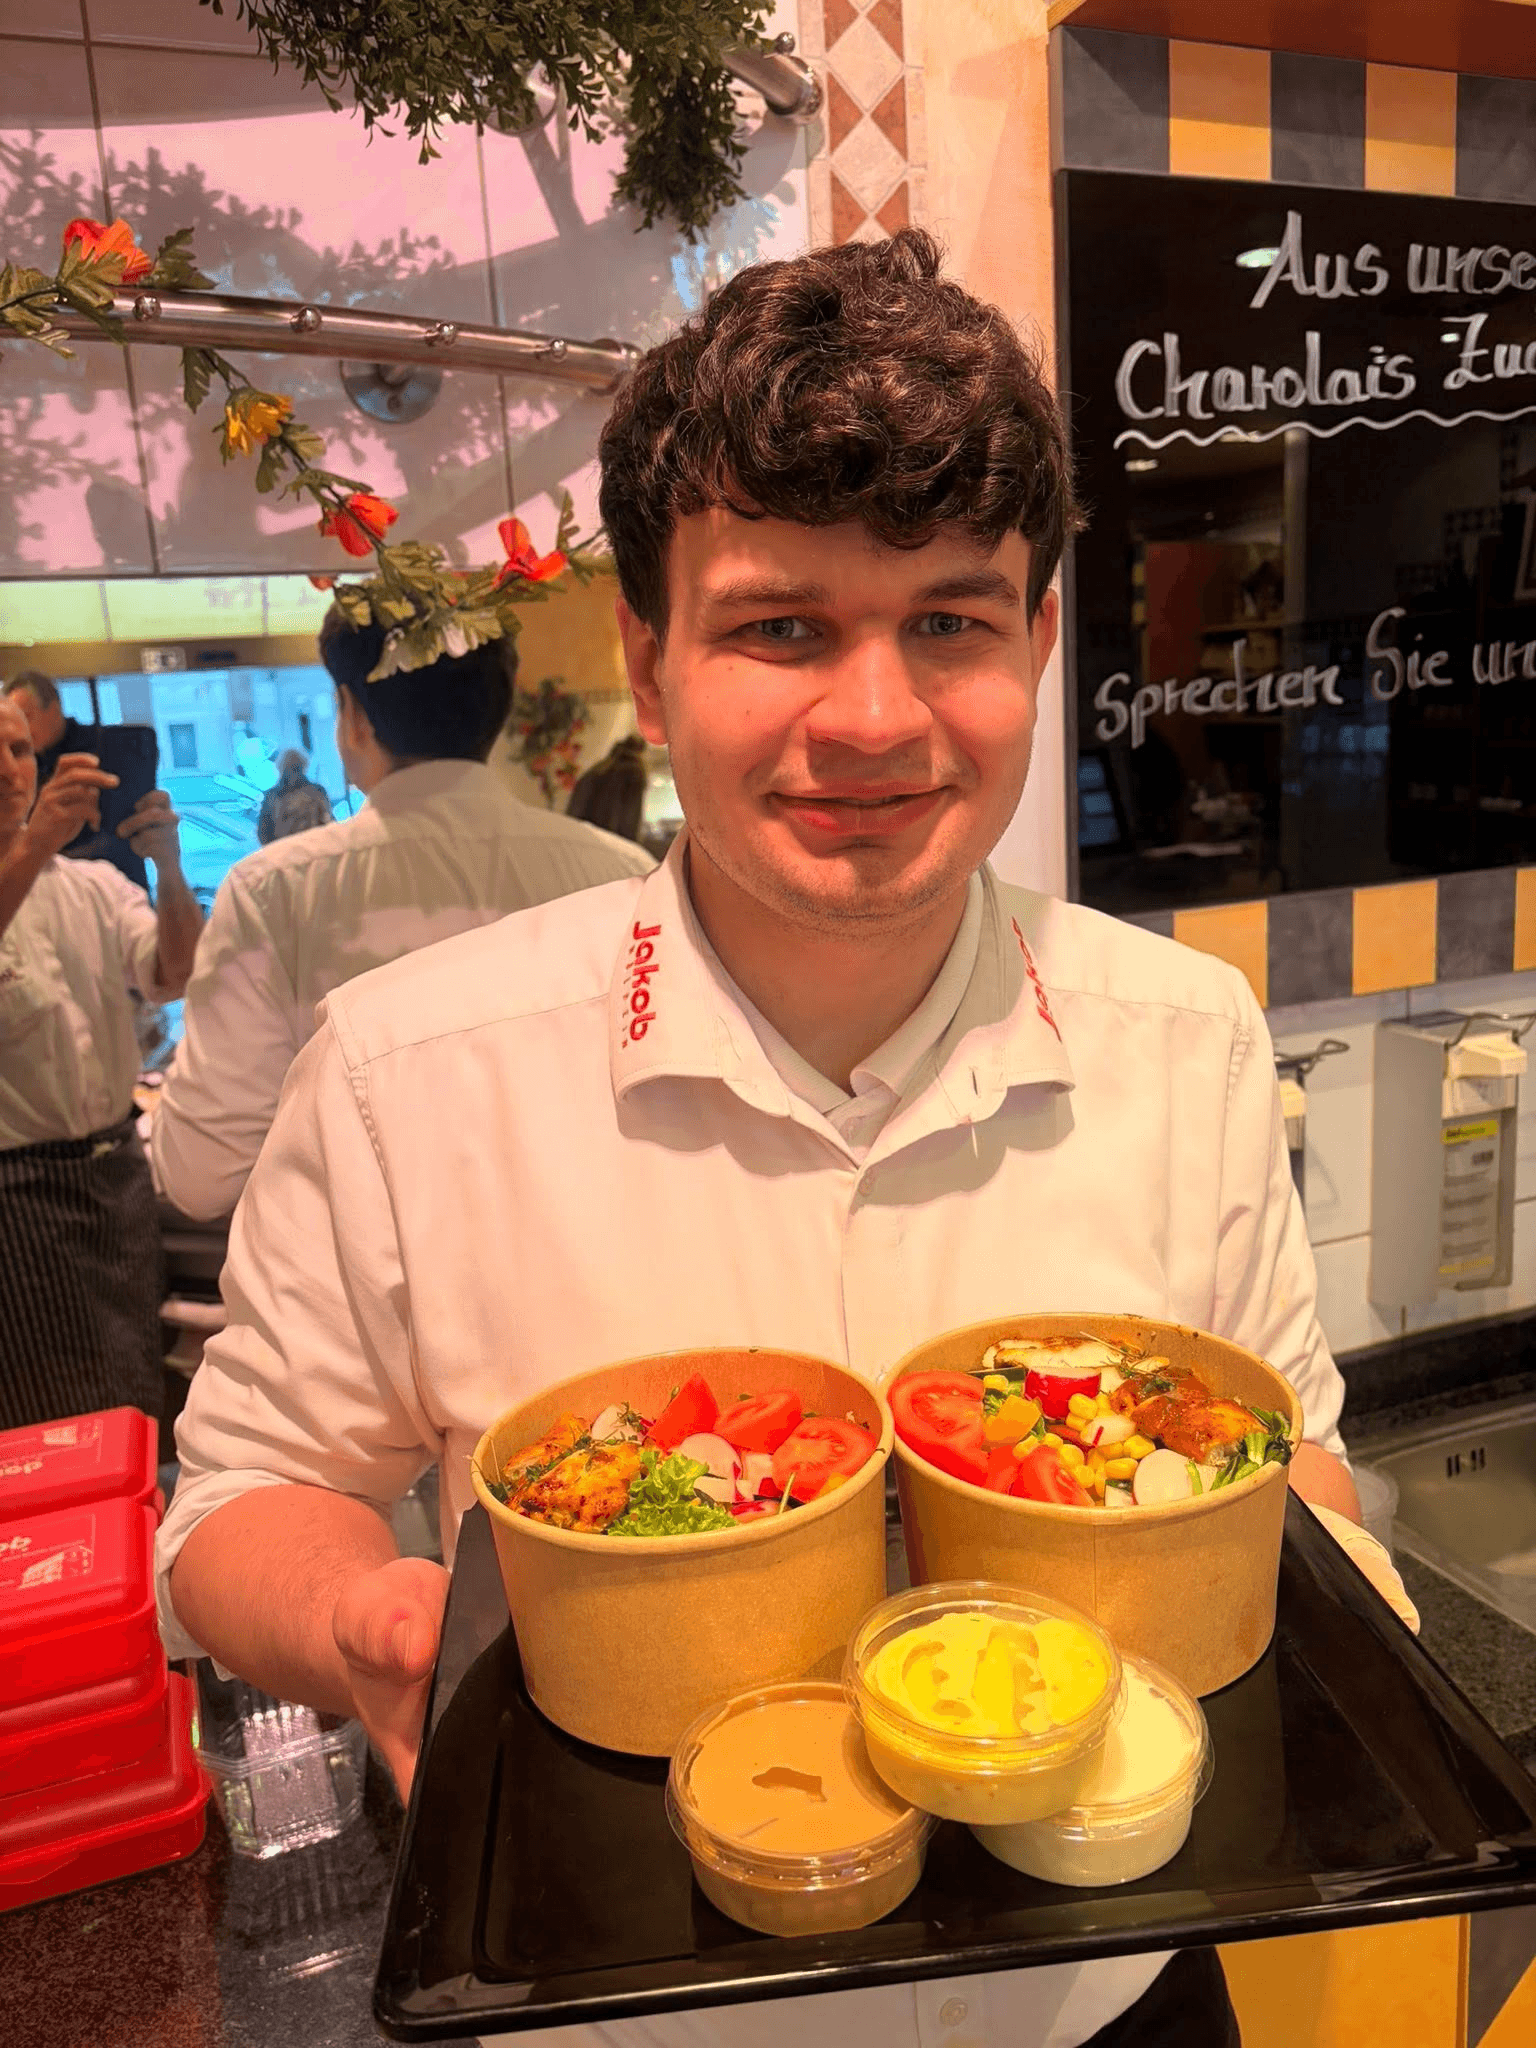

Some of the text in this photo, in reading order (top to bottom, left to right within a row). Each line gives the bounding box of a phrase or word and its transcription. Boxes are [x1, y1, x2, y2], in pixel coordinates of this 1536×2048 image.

[1250, 210, 1536, 309] Aus unse
[1114, 330, 1417, 420] Charolais
[1094, 637, 1344, 750] Sprechen
[1366, 606, 1453, 700] Sie
[629, 920, 662, 1042] Jakob
